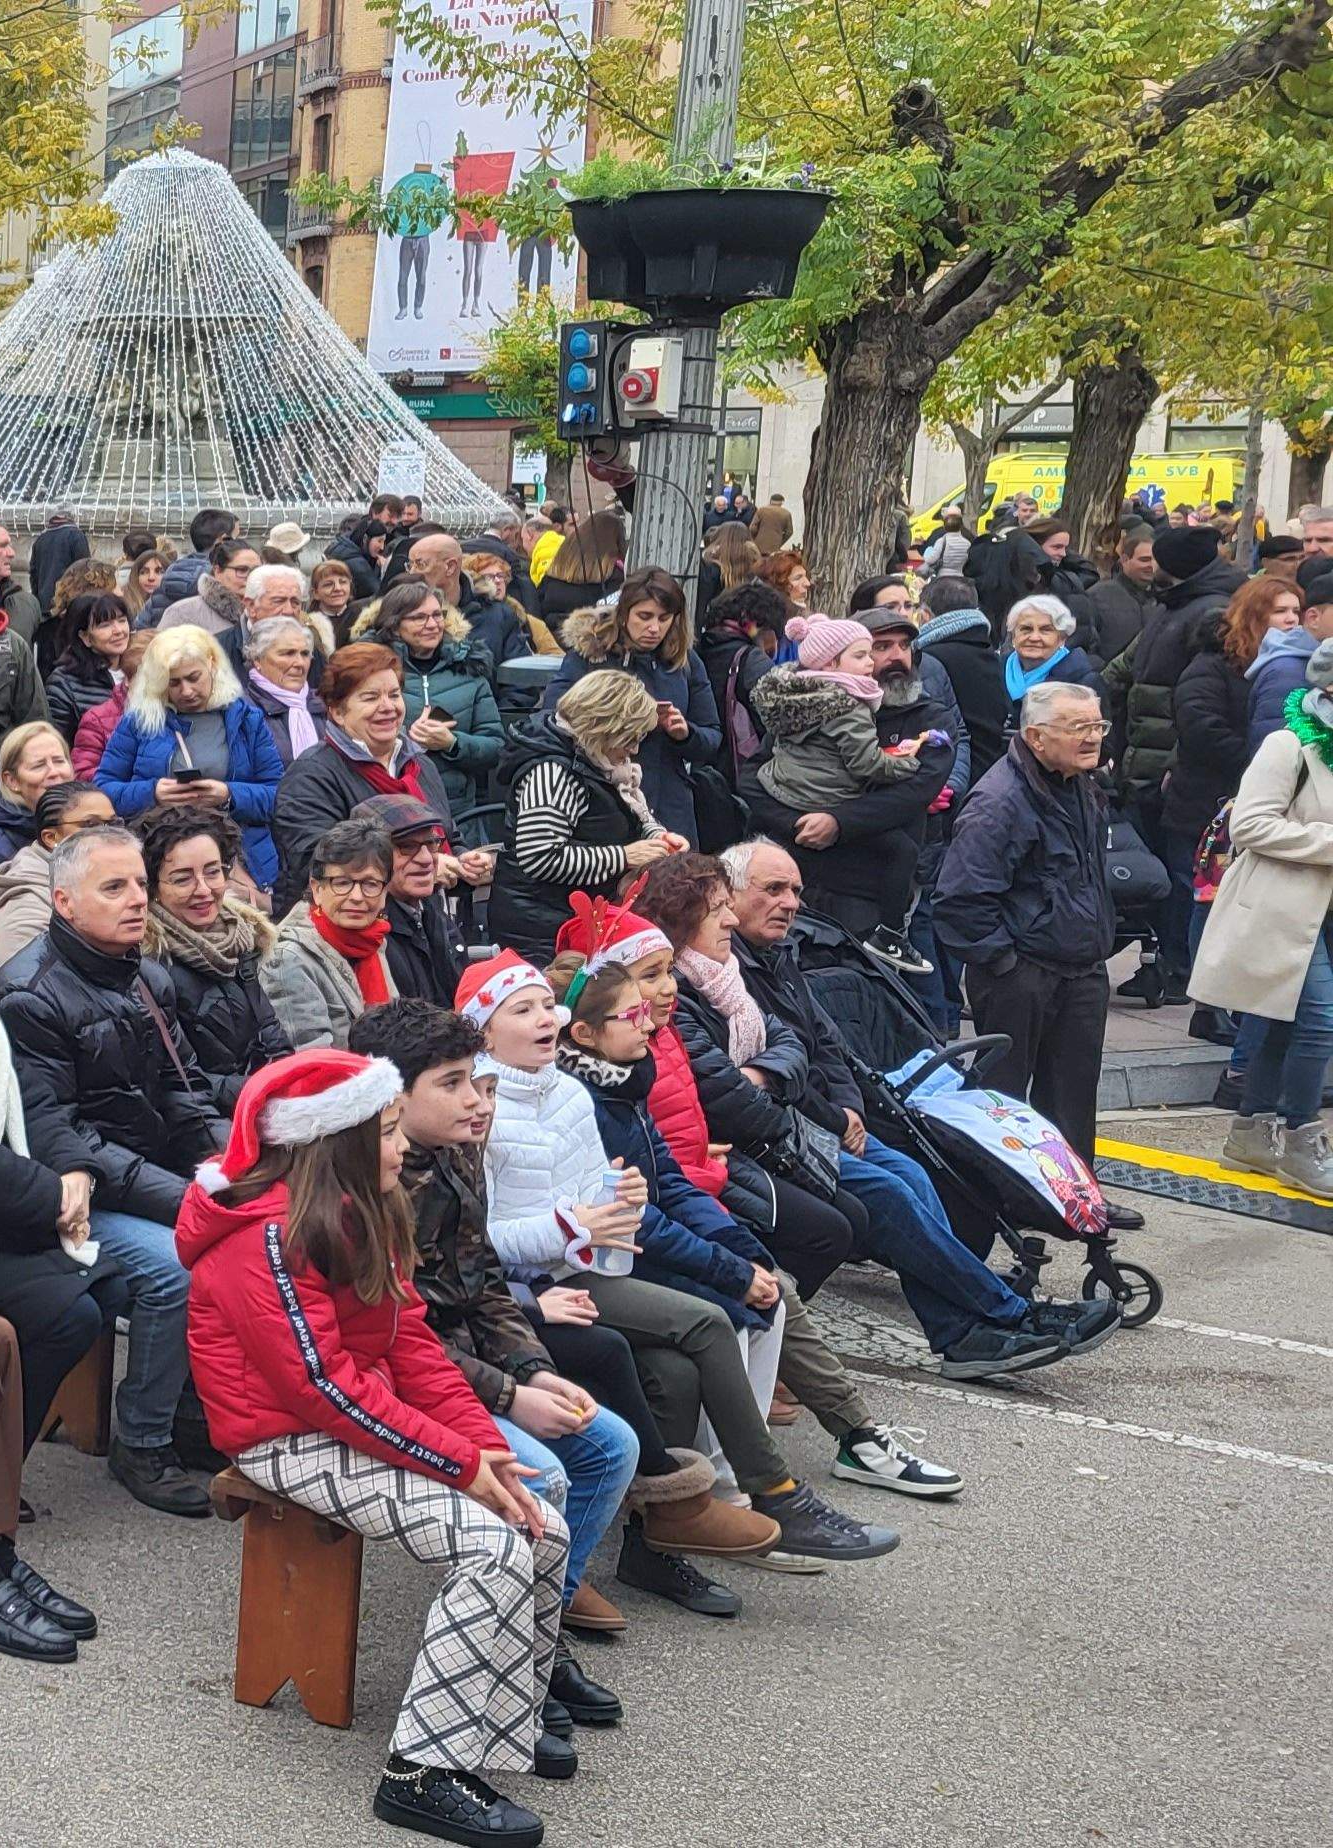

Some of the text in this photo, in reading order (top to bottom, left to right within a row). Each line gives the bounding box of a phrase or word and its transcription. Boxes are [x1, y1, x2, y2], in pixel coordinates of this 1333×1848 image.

[454, 14, 471, 30] la
[479, 4, 560, 27] Navidad
[1166, 466, 1199, 477] SVB
